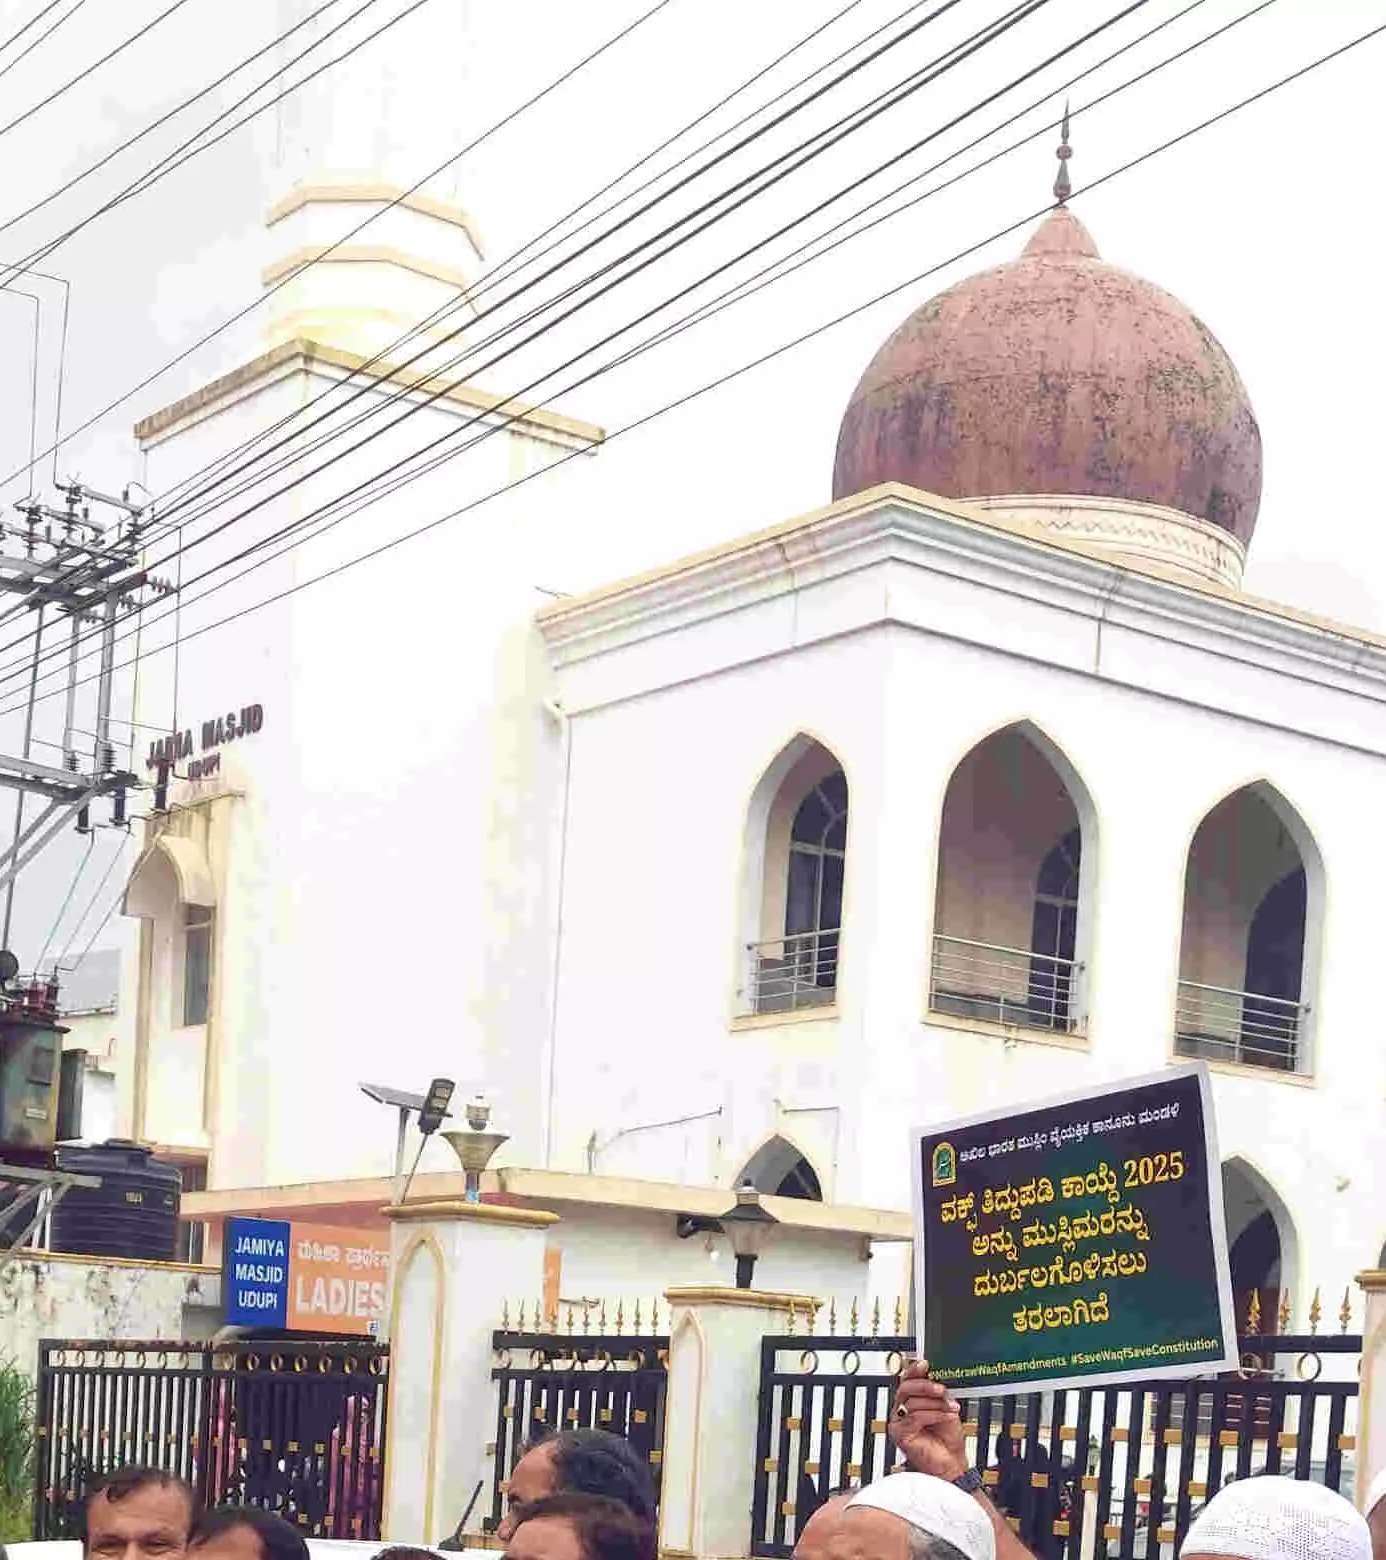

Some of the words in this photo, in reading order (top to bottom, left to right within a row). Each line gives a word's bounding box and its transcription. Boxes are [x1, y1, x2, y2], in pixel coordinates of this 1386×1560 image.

[202, 704, 263, 750] MASJID
[981, 1176, 1054, 1221] ತಿದ್ದುಪಡಿ
[1061, 1161, 1122, 1203] ಕಾಯ್ದೆ
[1124, 1151, 1185, 1189] 2025
[235, 1236, 285, 1257] JAMIYA
[972, 1227, 1020, 1261] ಅನ್ನು
[1022, 1206, 1151, 1253] ಮುಸ್ಲಿಮರನ್ನು
[235, 1264, 283, 1284] MASJID
[972, 1250, 1148, 1298] ದುರ್ಬಲಗೊಳಿಸಲು
[238, 1290, 277, 1310] UDUPI
[296, 1275, 386, 1317] LADIES
[1012, 1291, 1110, 1334] ತರಲಾಗಿದೆ
[1070, 1336, 1219, 1365] #SaveWaqfSaveConstitution
